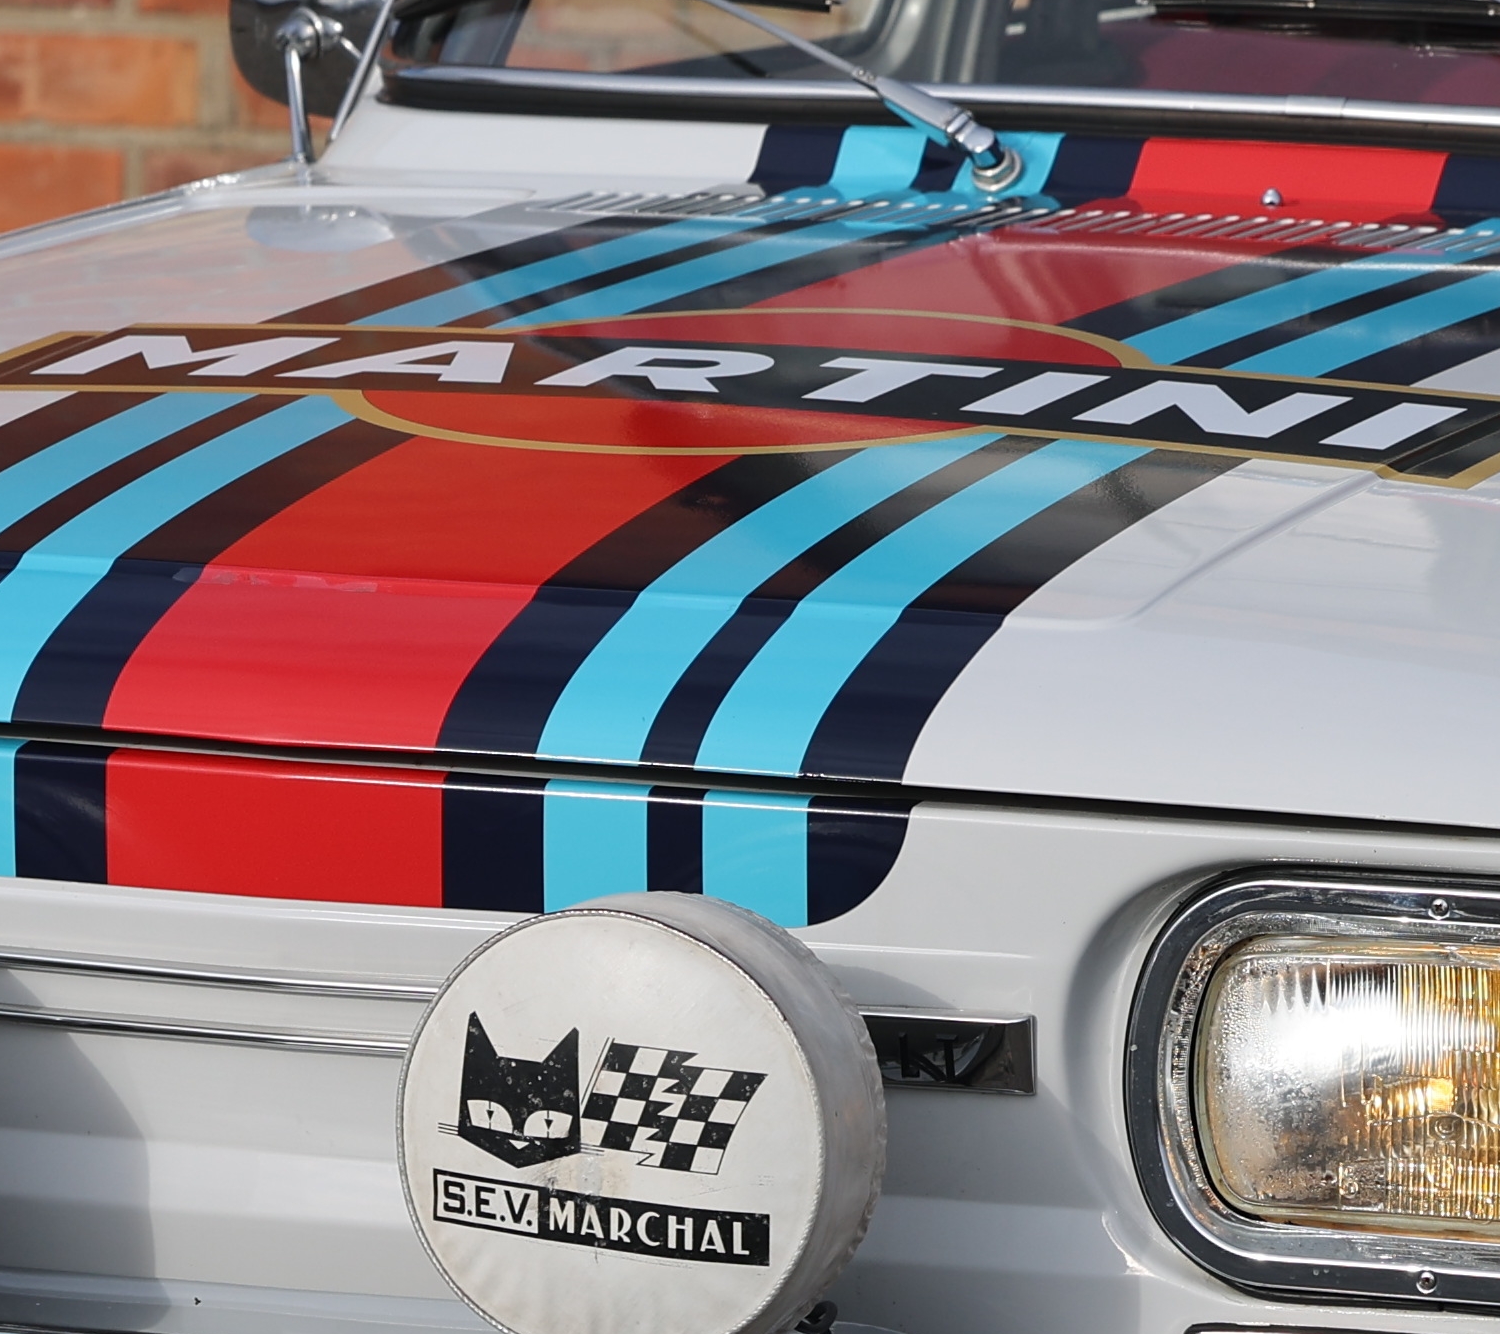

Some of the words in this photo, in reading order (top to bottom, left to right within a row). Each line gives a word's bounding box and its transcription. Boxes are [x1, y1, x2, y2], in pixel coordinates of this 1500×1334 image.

[30, 334, 1469, 450] MARTINI
[442, 1183, 533, 1226] S.E.V.
[549, 1200, 750, 1255] MARCHAL
